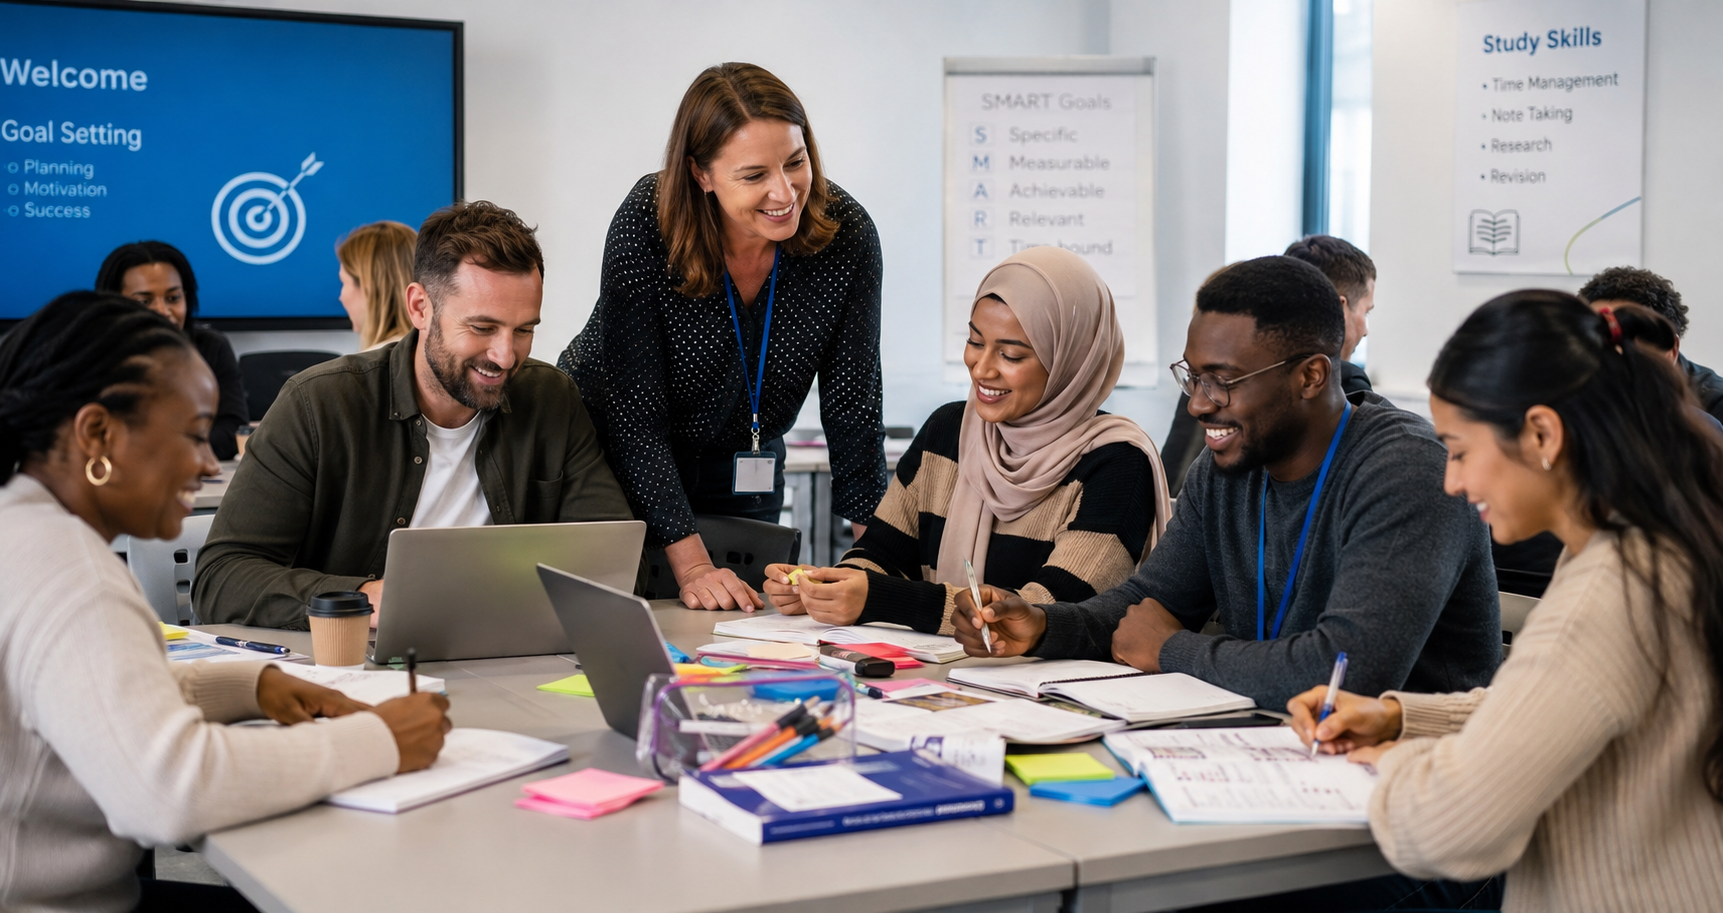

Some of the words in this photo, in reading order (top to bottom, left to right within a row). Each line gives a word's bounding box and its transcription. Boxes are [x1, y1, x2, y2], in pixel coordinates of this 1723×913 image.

[1483, 32, 1540, 56] Study
[1547, 26, 1602, 49] Skills
[0, 57, 148, 91] Welcome
[1492, 77, 1525, 92] Time
[1528, 72, 1618, 92] Management
[981, 93, 1052, 110] SMART
[1058, 93, 1112, 111] Goals
[1492, 108, 1525, 123] Note
[1528, 106, 1573, 124] Taking
[1, 119, 53, 143] Goal
[61, 121, 142, 151] Setting
[975, 126, 987, 144] S
[1009, 126, 1078, 146] Specific
[1491, 137, 1552, 153] Research
[24, 159, 94, 179] Planning
[973, 154, 990, 171] M
[1009, 155, 1111, 171] Measurable
[1491, 168, 1546, 184] Revision
[25, 181, 107, 197] Motivation
[973, 182, 989, 199] A
[1009, 183, 1106, 199] Achievable
[25, 202, 90, 218] Success
[974, 210, 987, 227] R
[1009, 211, 1085, 227] Relevant
[974, 238, 987, 255] T
